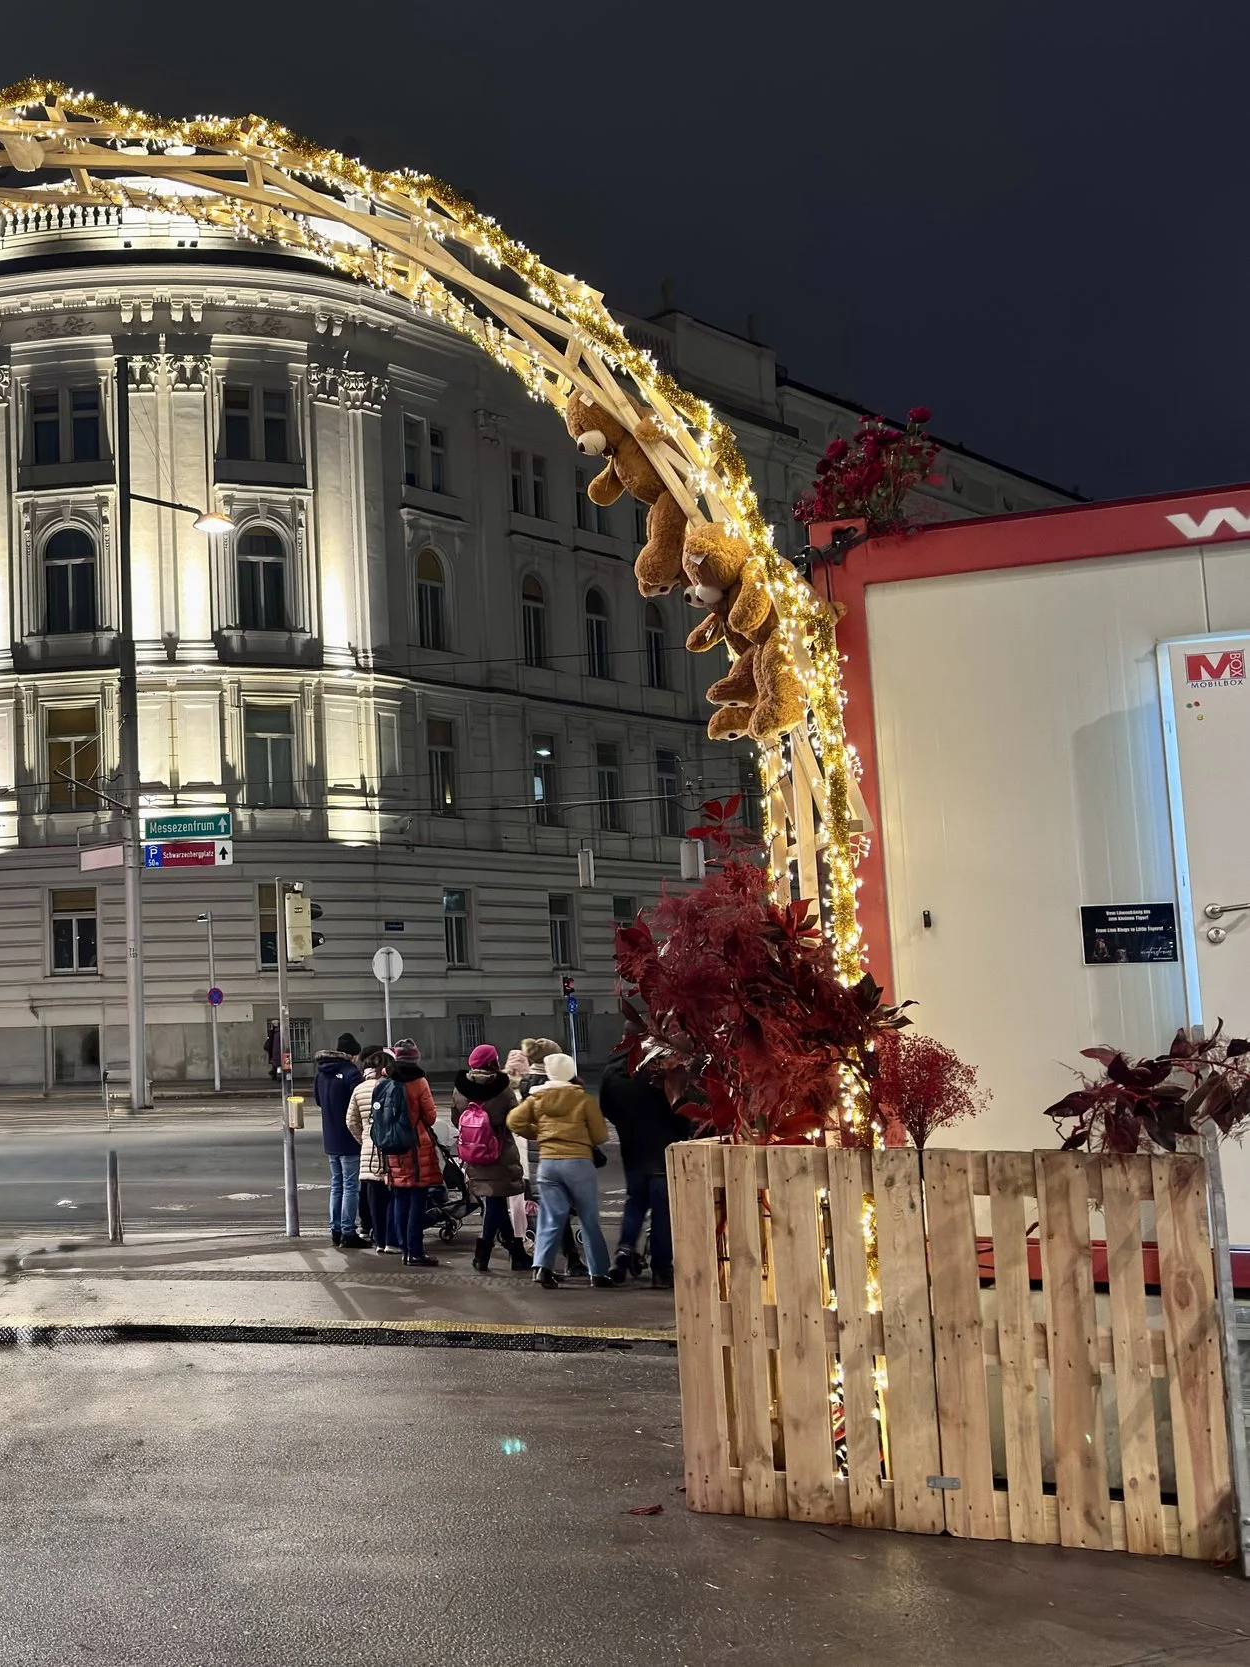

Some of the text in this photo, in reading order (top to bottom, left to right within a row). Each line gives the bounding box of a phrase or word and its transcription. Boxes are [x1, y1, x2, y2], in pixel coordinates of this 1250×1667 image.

[1230, 653, 1243, 677] BOX
[1191, 680, 1243, 688] MOBILBOX
[149, 821, 215, 834] Messezentrum
[162, 850, 214, 859] Schwarzenbergplatz
